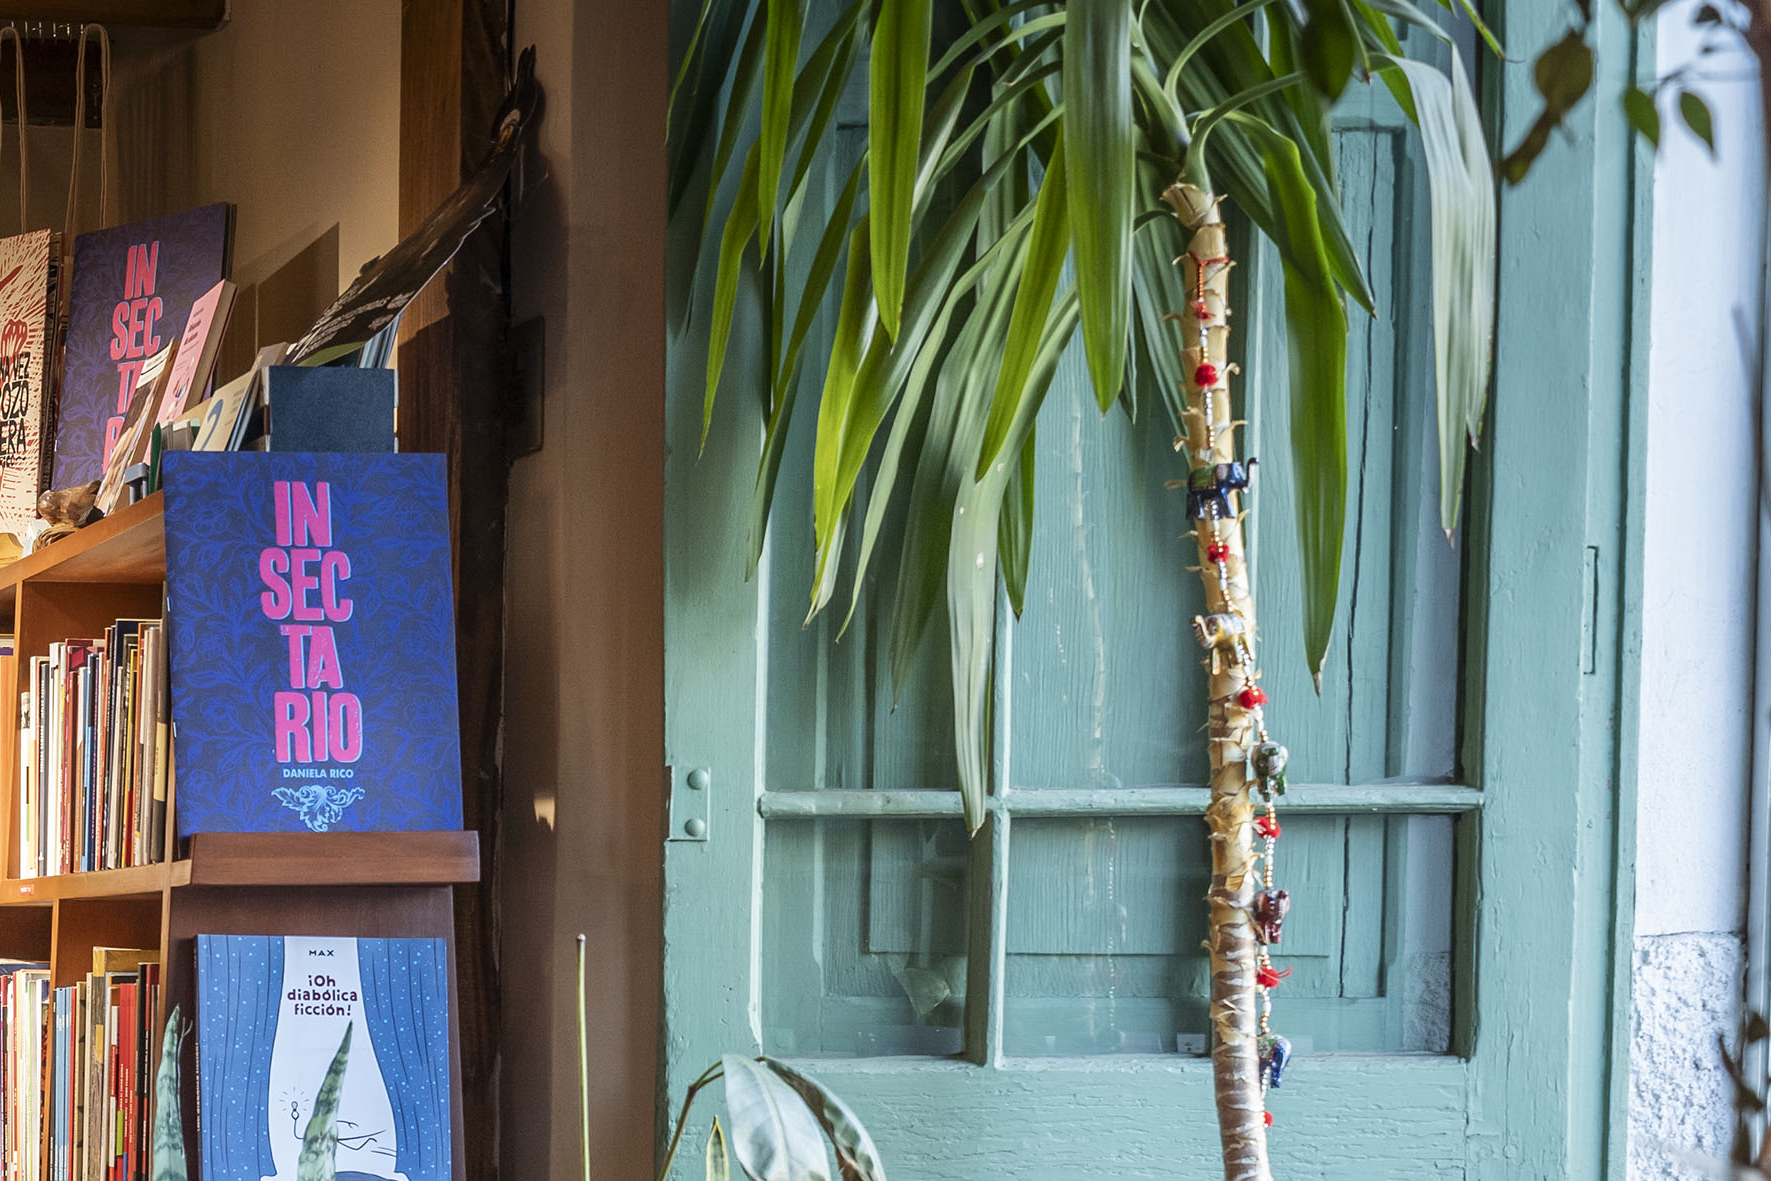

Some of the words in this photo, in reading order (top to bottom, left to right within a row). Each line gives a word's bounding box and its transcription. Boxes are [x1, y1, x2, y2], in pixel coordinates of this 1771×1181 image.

[124, 240, 160, 300] IN
[109, 296, 164, 361] SEC
[13, 352, 30, 380] VEZ
[273, 480, 333, 547] IN
[259, 547, 353, 622] SEC
[280, 625, 344, 690] TA
[273, 691, 363, 763] RIO
[283, 768, 328, 779] DANIELA
[329, 768, 354, 779] RICO
[287, 988, 358, 1002] diabólica
[294, 1003, 353, 1017] ficción!
[308, 975, 336, 988] ¡Oh
